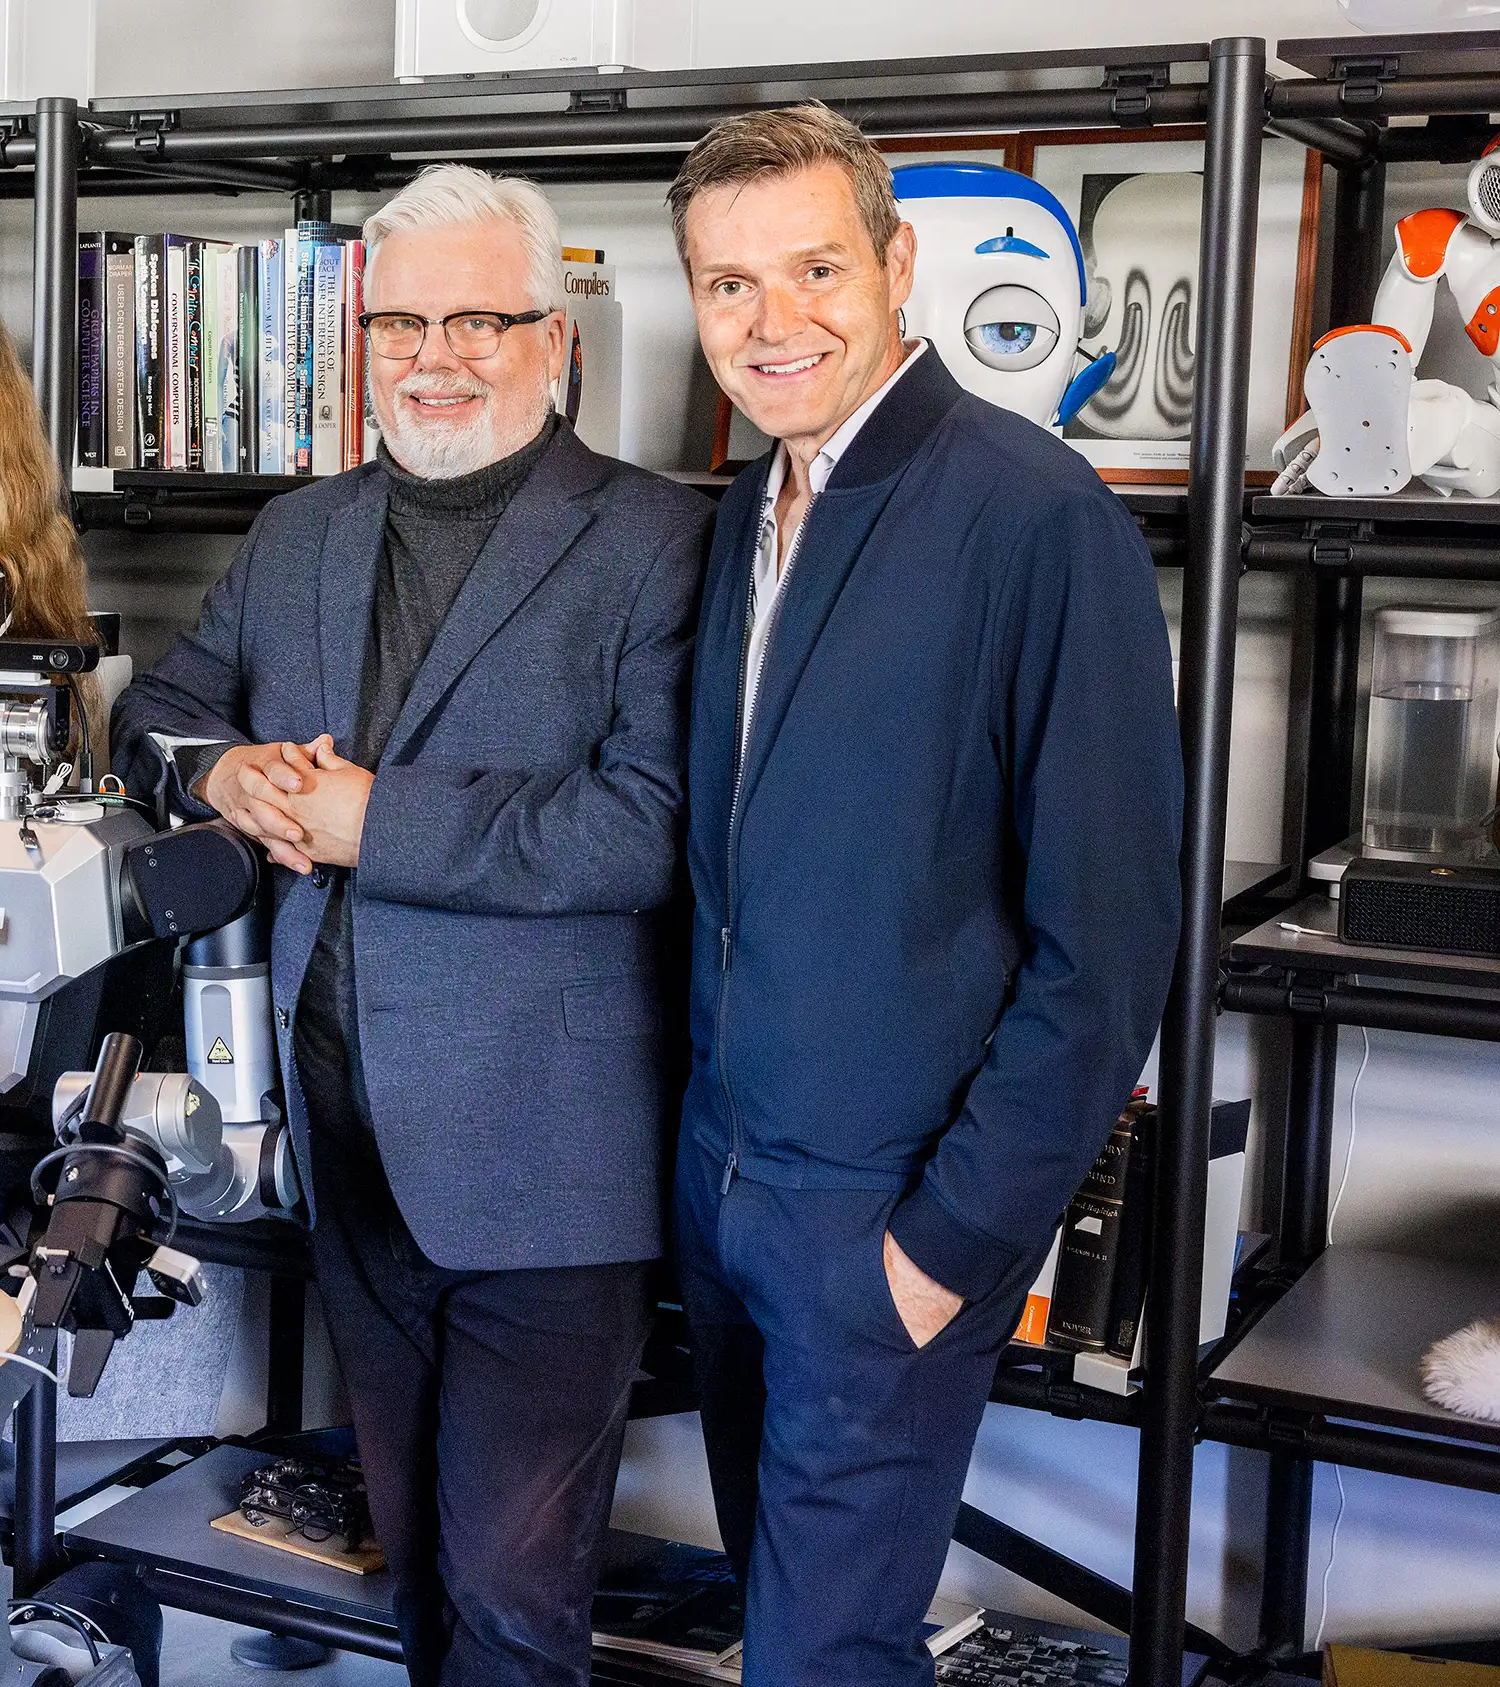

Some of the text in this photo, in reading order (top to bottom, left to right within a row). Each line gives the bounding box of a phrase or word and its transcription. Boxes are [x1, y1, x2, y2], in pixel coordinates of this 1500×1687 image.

[300, 252, 309, 278] Story
[318, 258, 340, 266] BOUT
[564, 271, 610, 299] Compilers
[139, 284, 150, 345] Computers
[148, 253, 159, 360] Spoken Dialogues
[188, 259, 202, 372] The Cognitive Computer
[300, 296, 308, 354] Simulations
[327, 274, 336, 372] THE ESSENTIALS OF
[82, 298, 90, 428] COMPUTER SCIENCE
[90, 309, 100, 416] GREAT PAPERS IN
[116, 284, 124, 432] USER CENTERED SYSTEM DESIGN
[171, 292, 180, 426] CONVERSATIONAL COMPUTERS
[286, 282, 296, 428] AFFECTIVE COMPUTING
[318, 275, 326, 400] USER INTERFACE DESIGN
[146, 376, 154, 395] Renato
[146, 402, 154, 416] Mori
[300, 370, 308, 406] Serious
[300, 408, 308, 440] Games
[1062, 1320, 1092, 1336] DOVER
